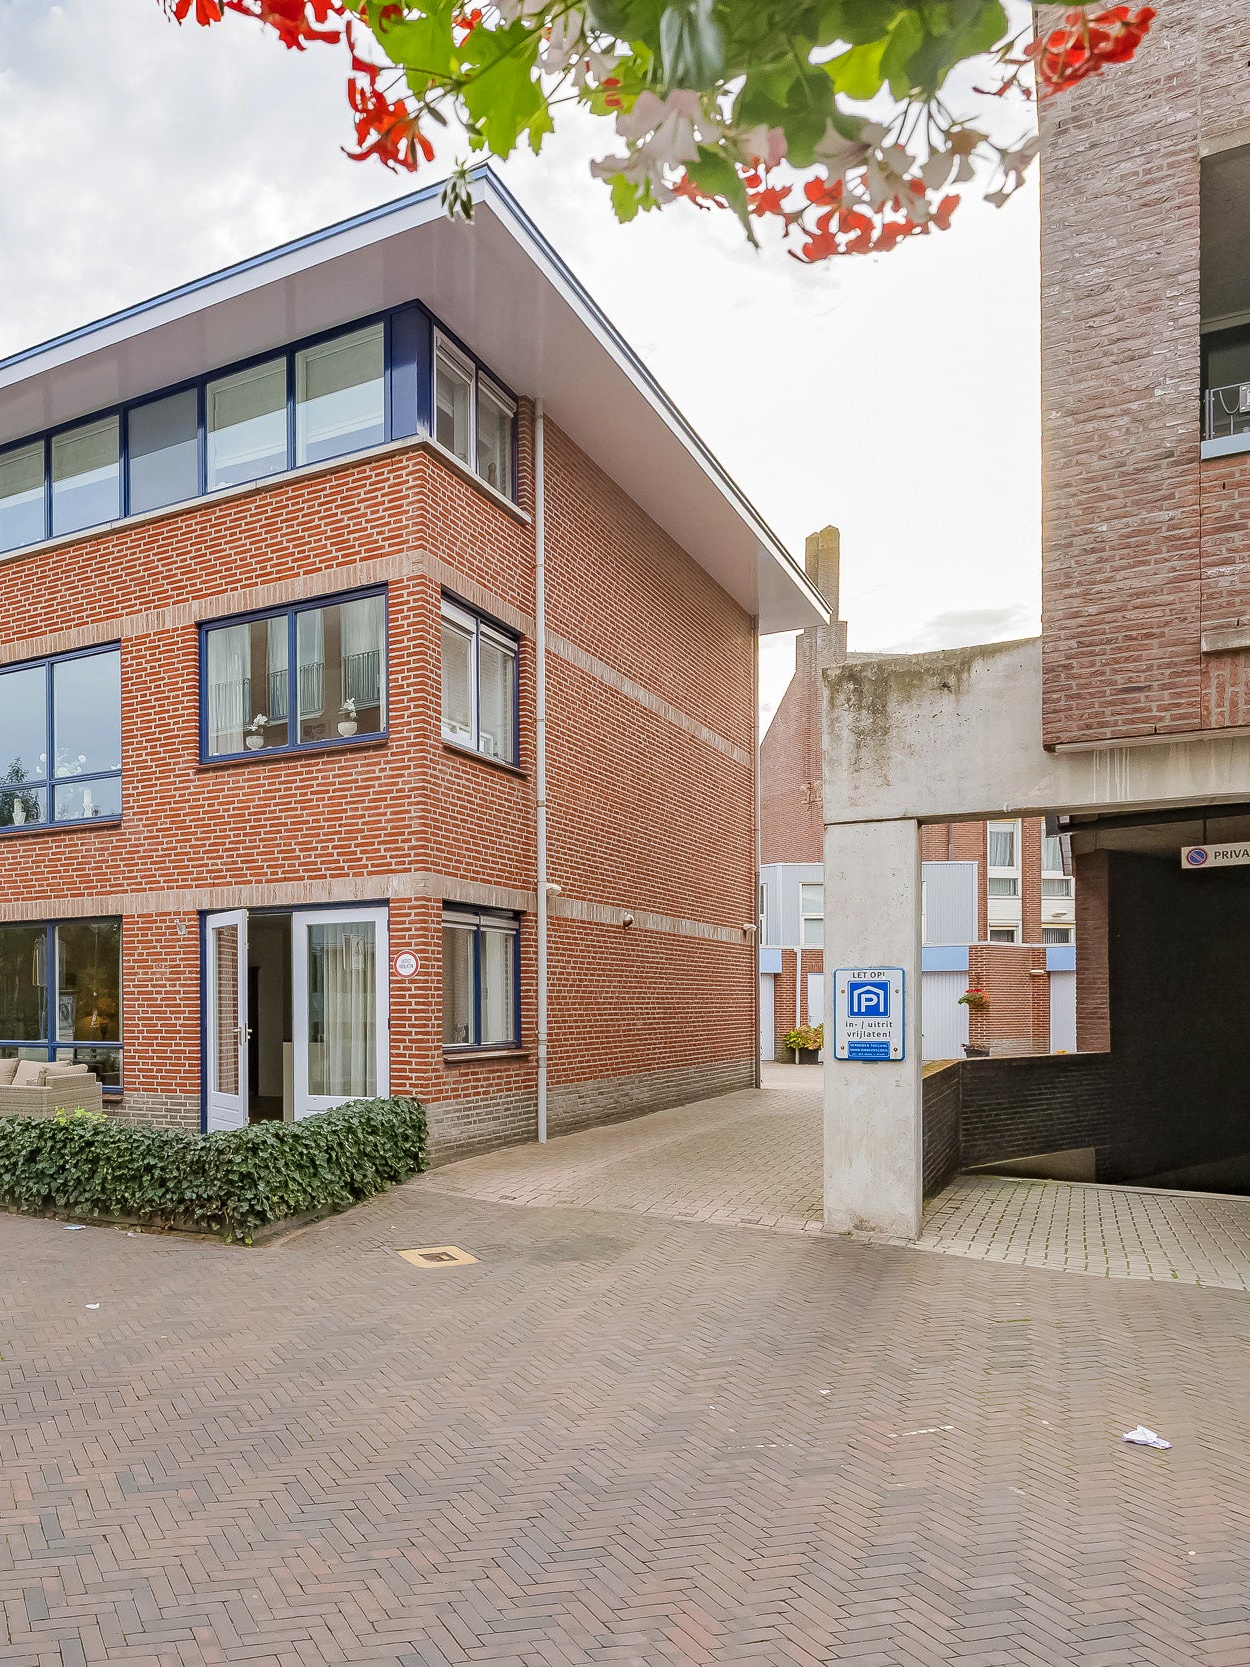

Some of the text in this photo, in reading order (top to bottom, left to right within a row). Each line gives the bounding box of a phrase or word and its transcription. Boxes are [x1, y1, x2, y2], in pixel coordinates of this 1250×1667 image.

[1214, 848, 1250, 860] PRIVA
[852, 971, 885, 979] LET OP!
[860, 993, 879, 1013] P
[845, 1020, 858, 1028] in-
[867, 1020, 893, 1028] uitrit
[846, 1030, 891, 1039] vrijlaten!
